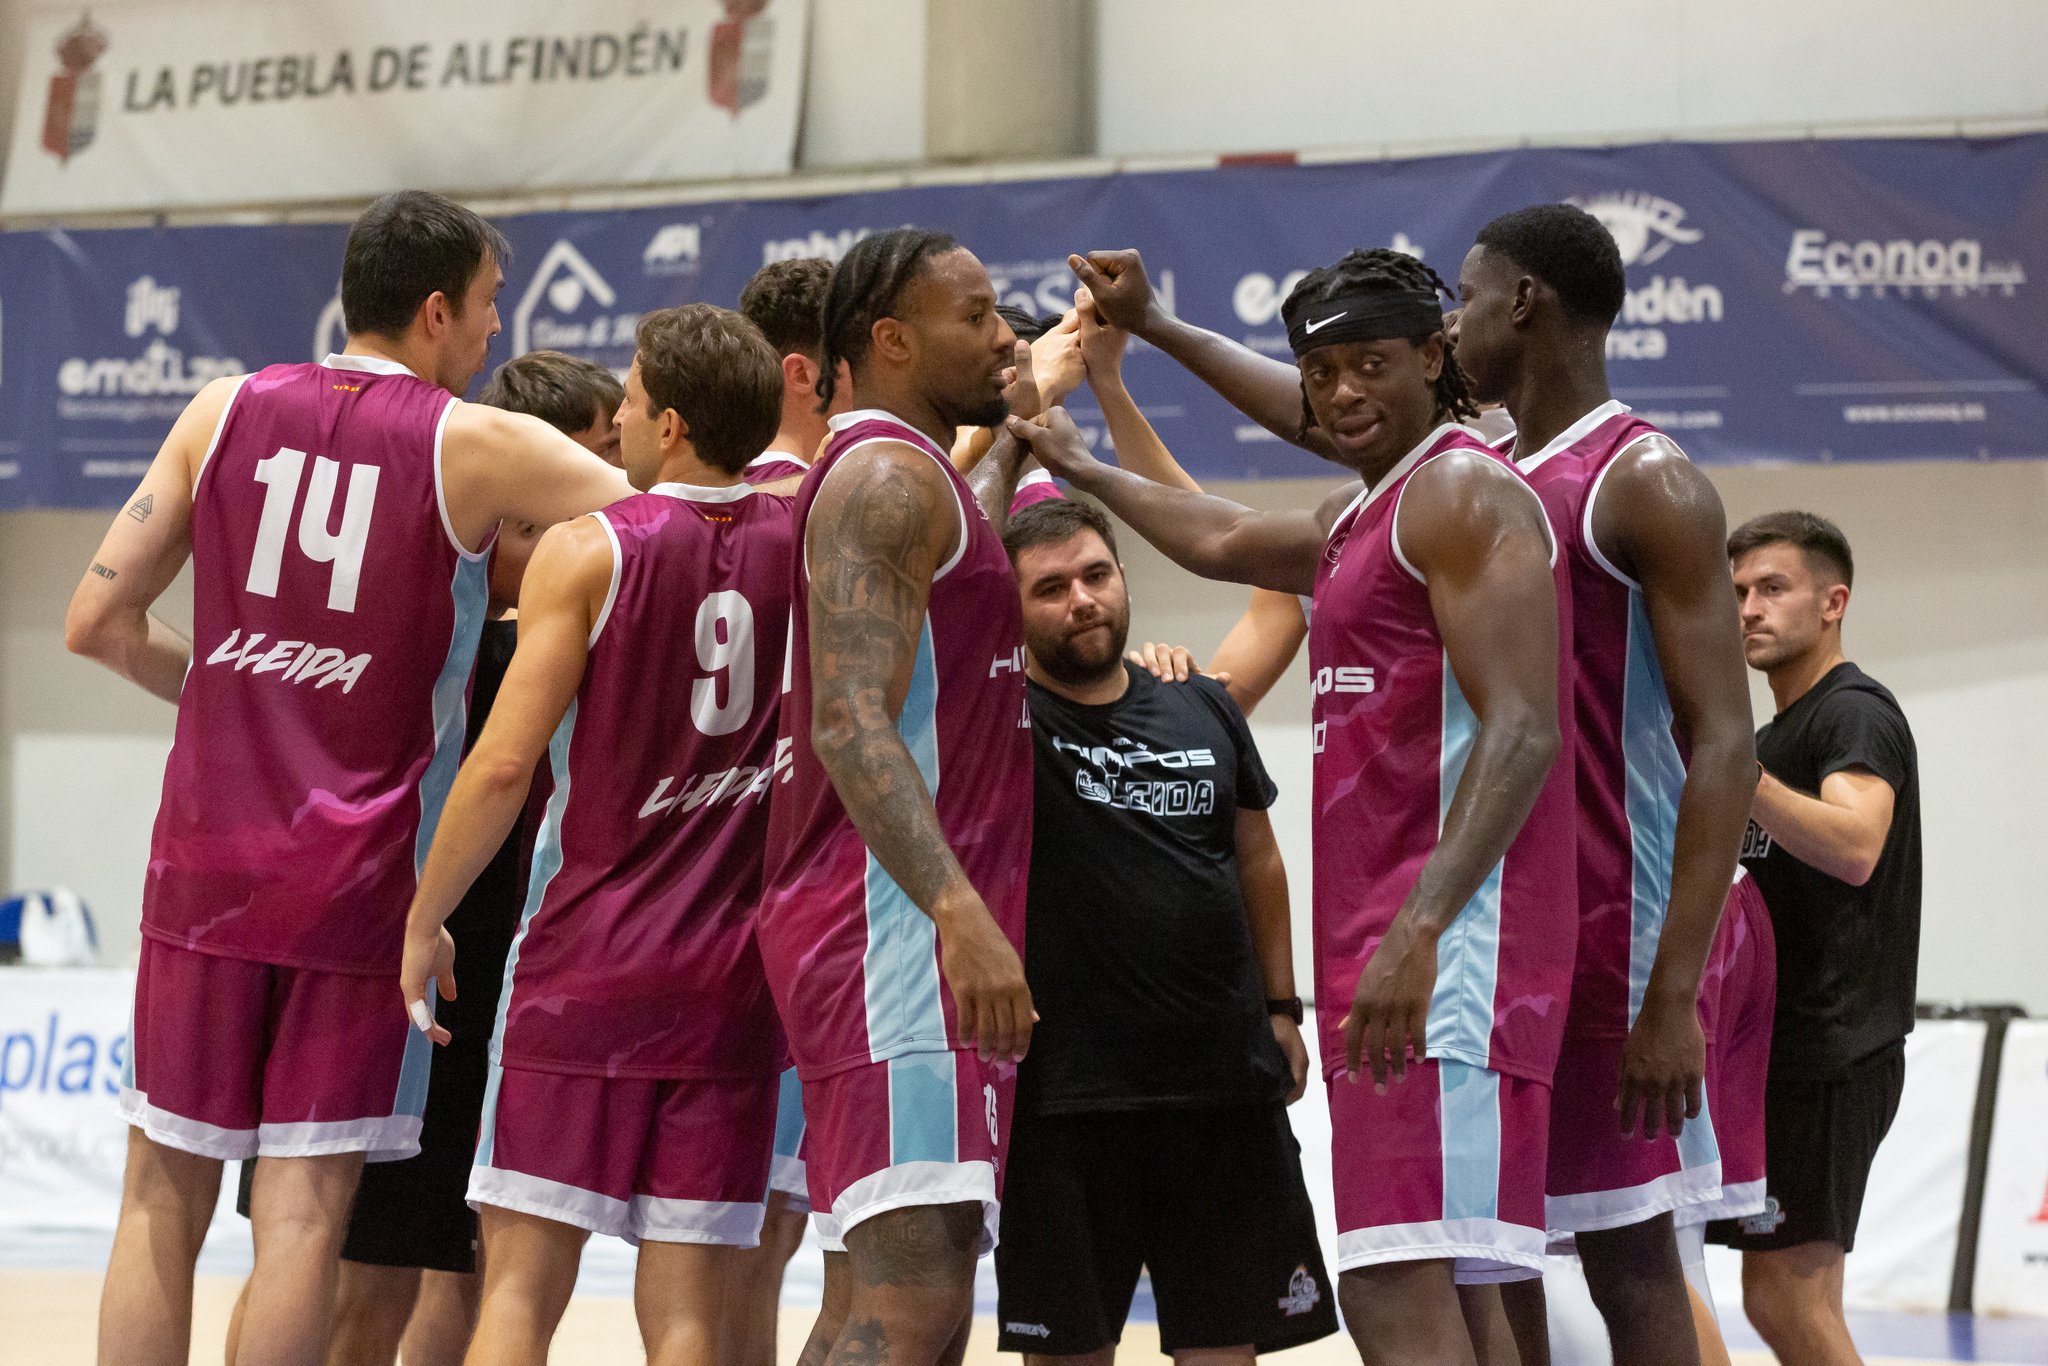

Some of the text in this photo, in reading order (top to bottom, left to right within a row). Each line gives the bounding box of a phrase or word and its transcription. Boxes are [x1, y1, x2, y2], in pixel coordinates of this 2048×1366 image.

[123, 20, 688, 112] LA PUEBLA DE ALFINDÉN
[245, 446, 382, 613] 14
[206, 628, 373, 695] LLEIDA
[690, 589, 755, 736] 9
